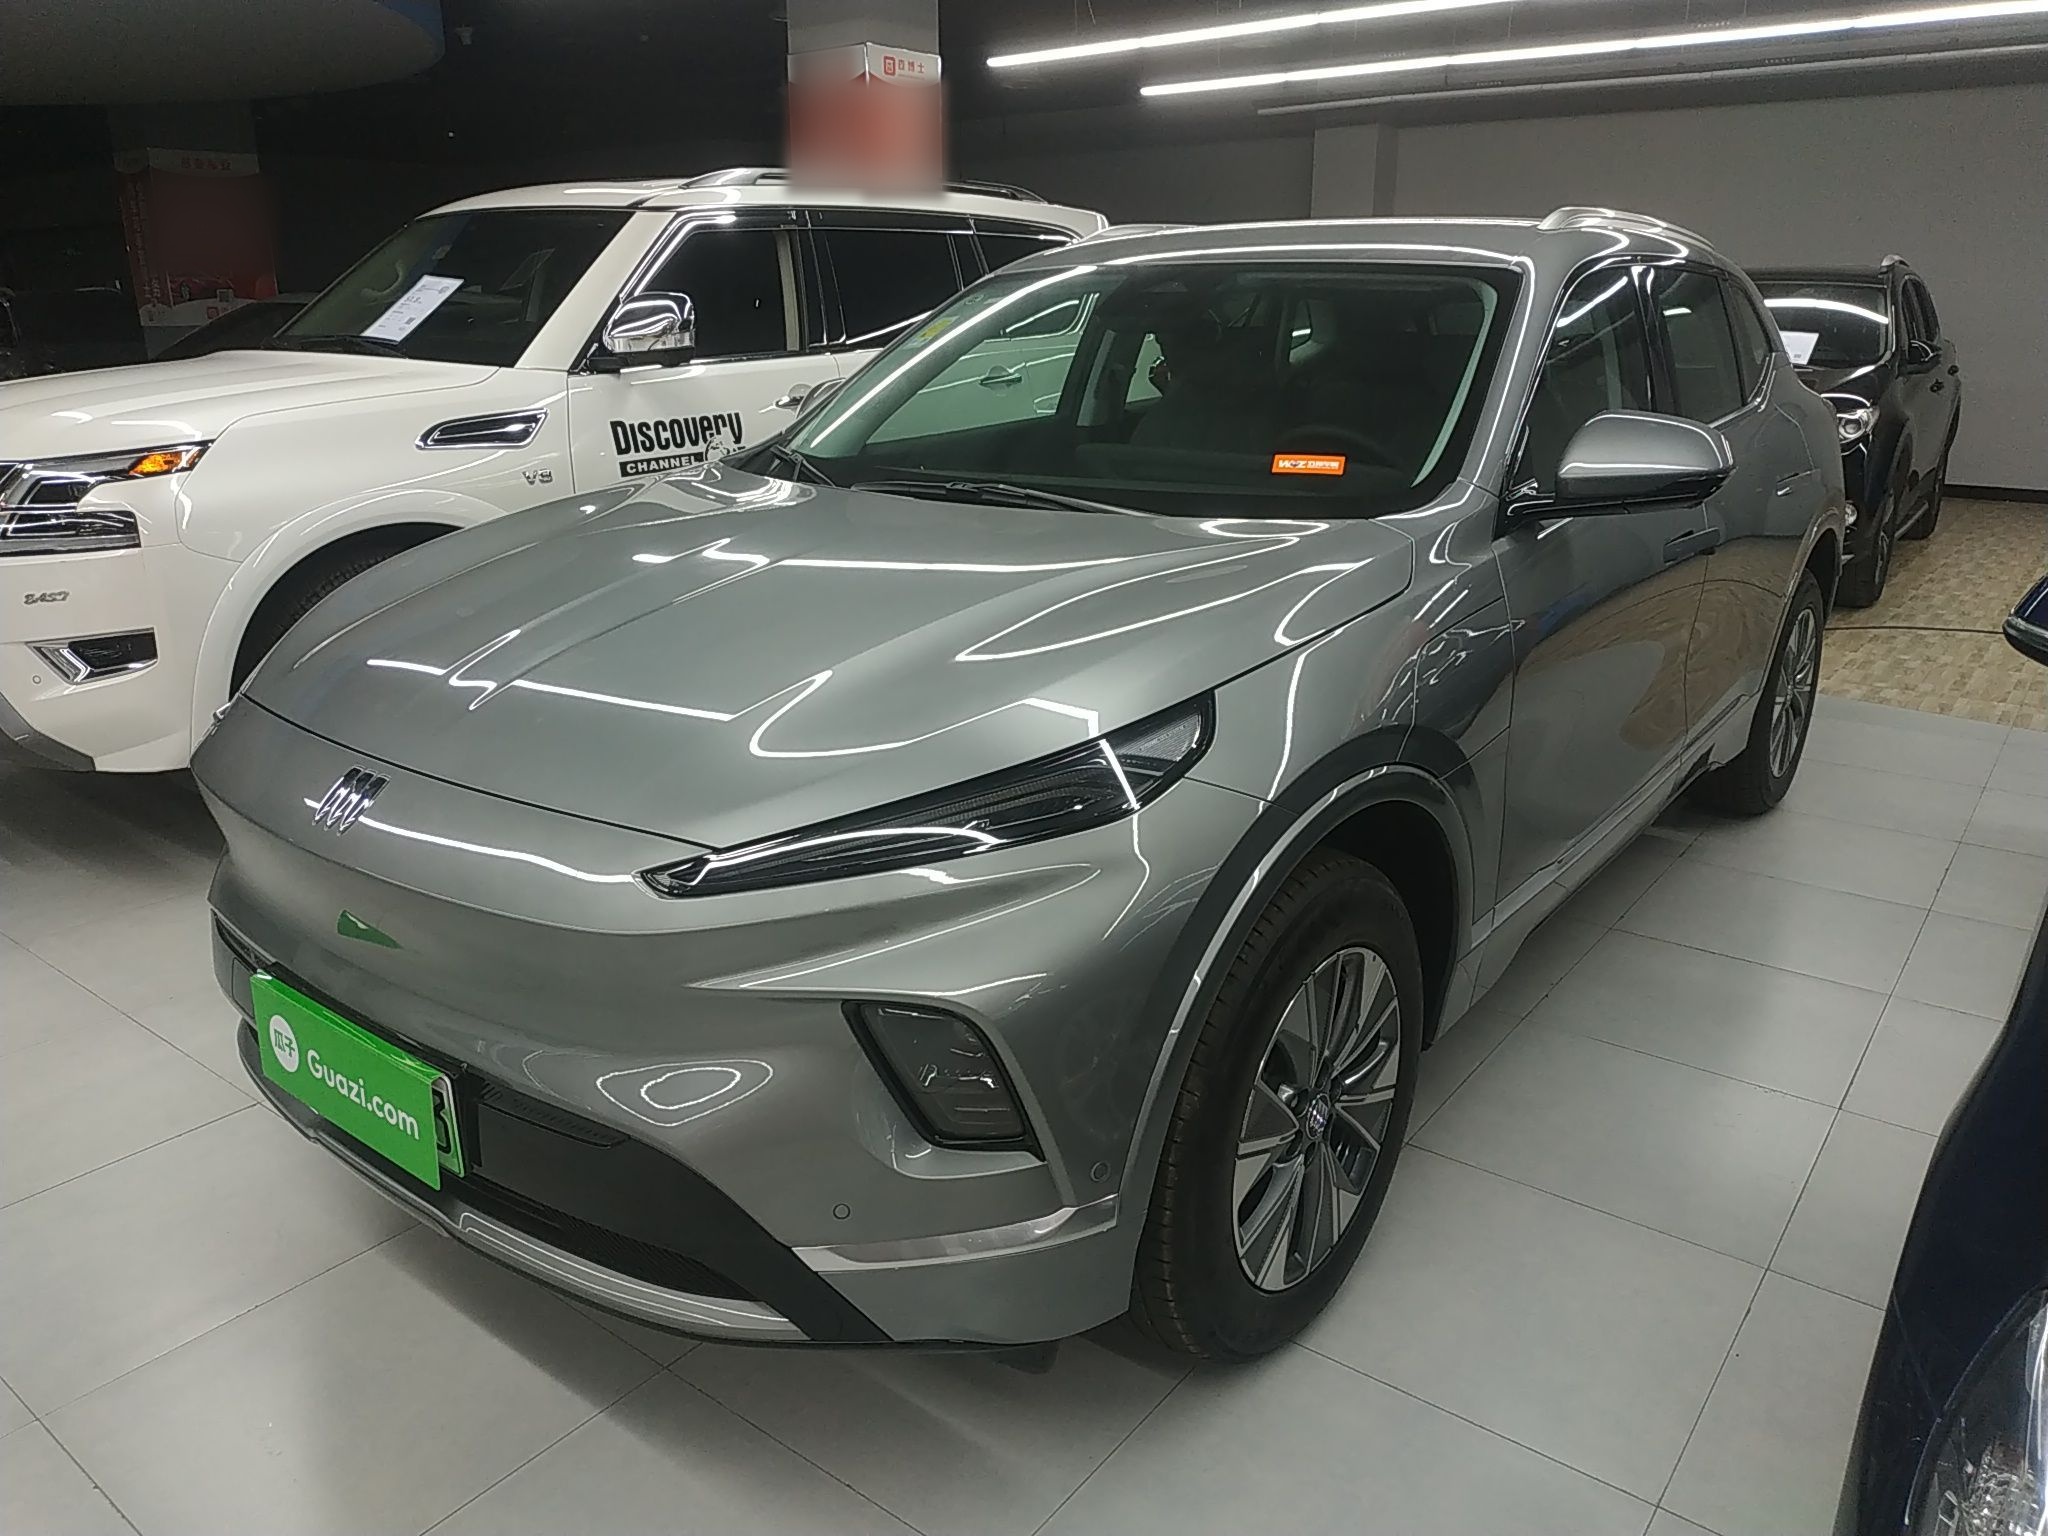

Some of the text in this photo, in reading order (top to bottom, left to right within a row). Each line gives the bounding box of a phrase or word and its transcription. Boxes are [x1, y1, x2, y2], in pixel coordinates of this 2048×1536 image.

[521, 468, 554, 486] V8
[626, 456, 700, 474] CHANNEL
[273, 1027, 296, 1058] 瓜子
[306, 1048, 421, 1141] Guazi.com
